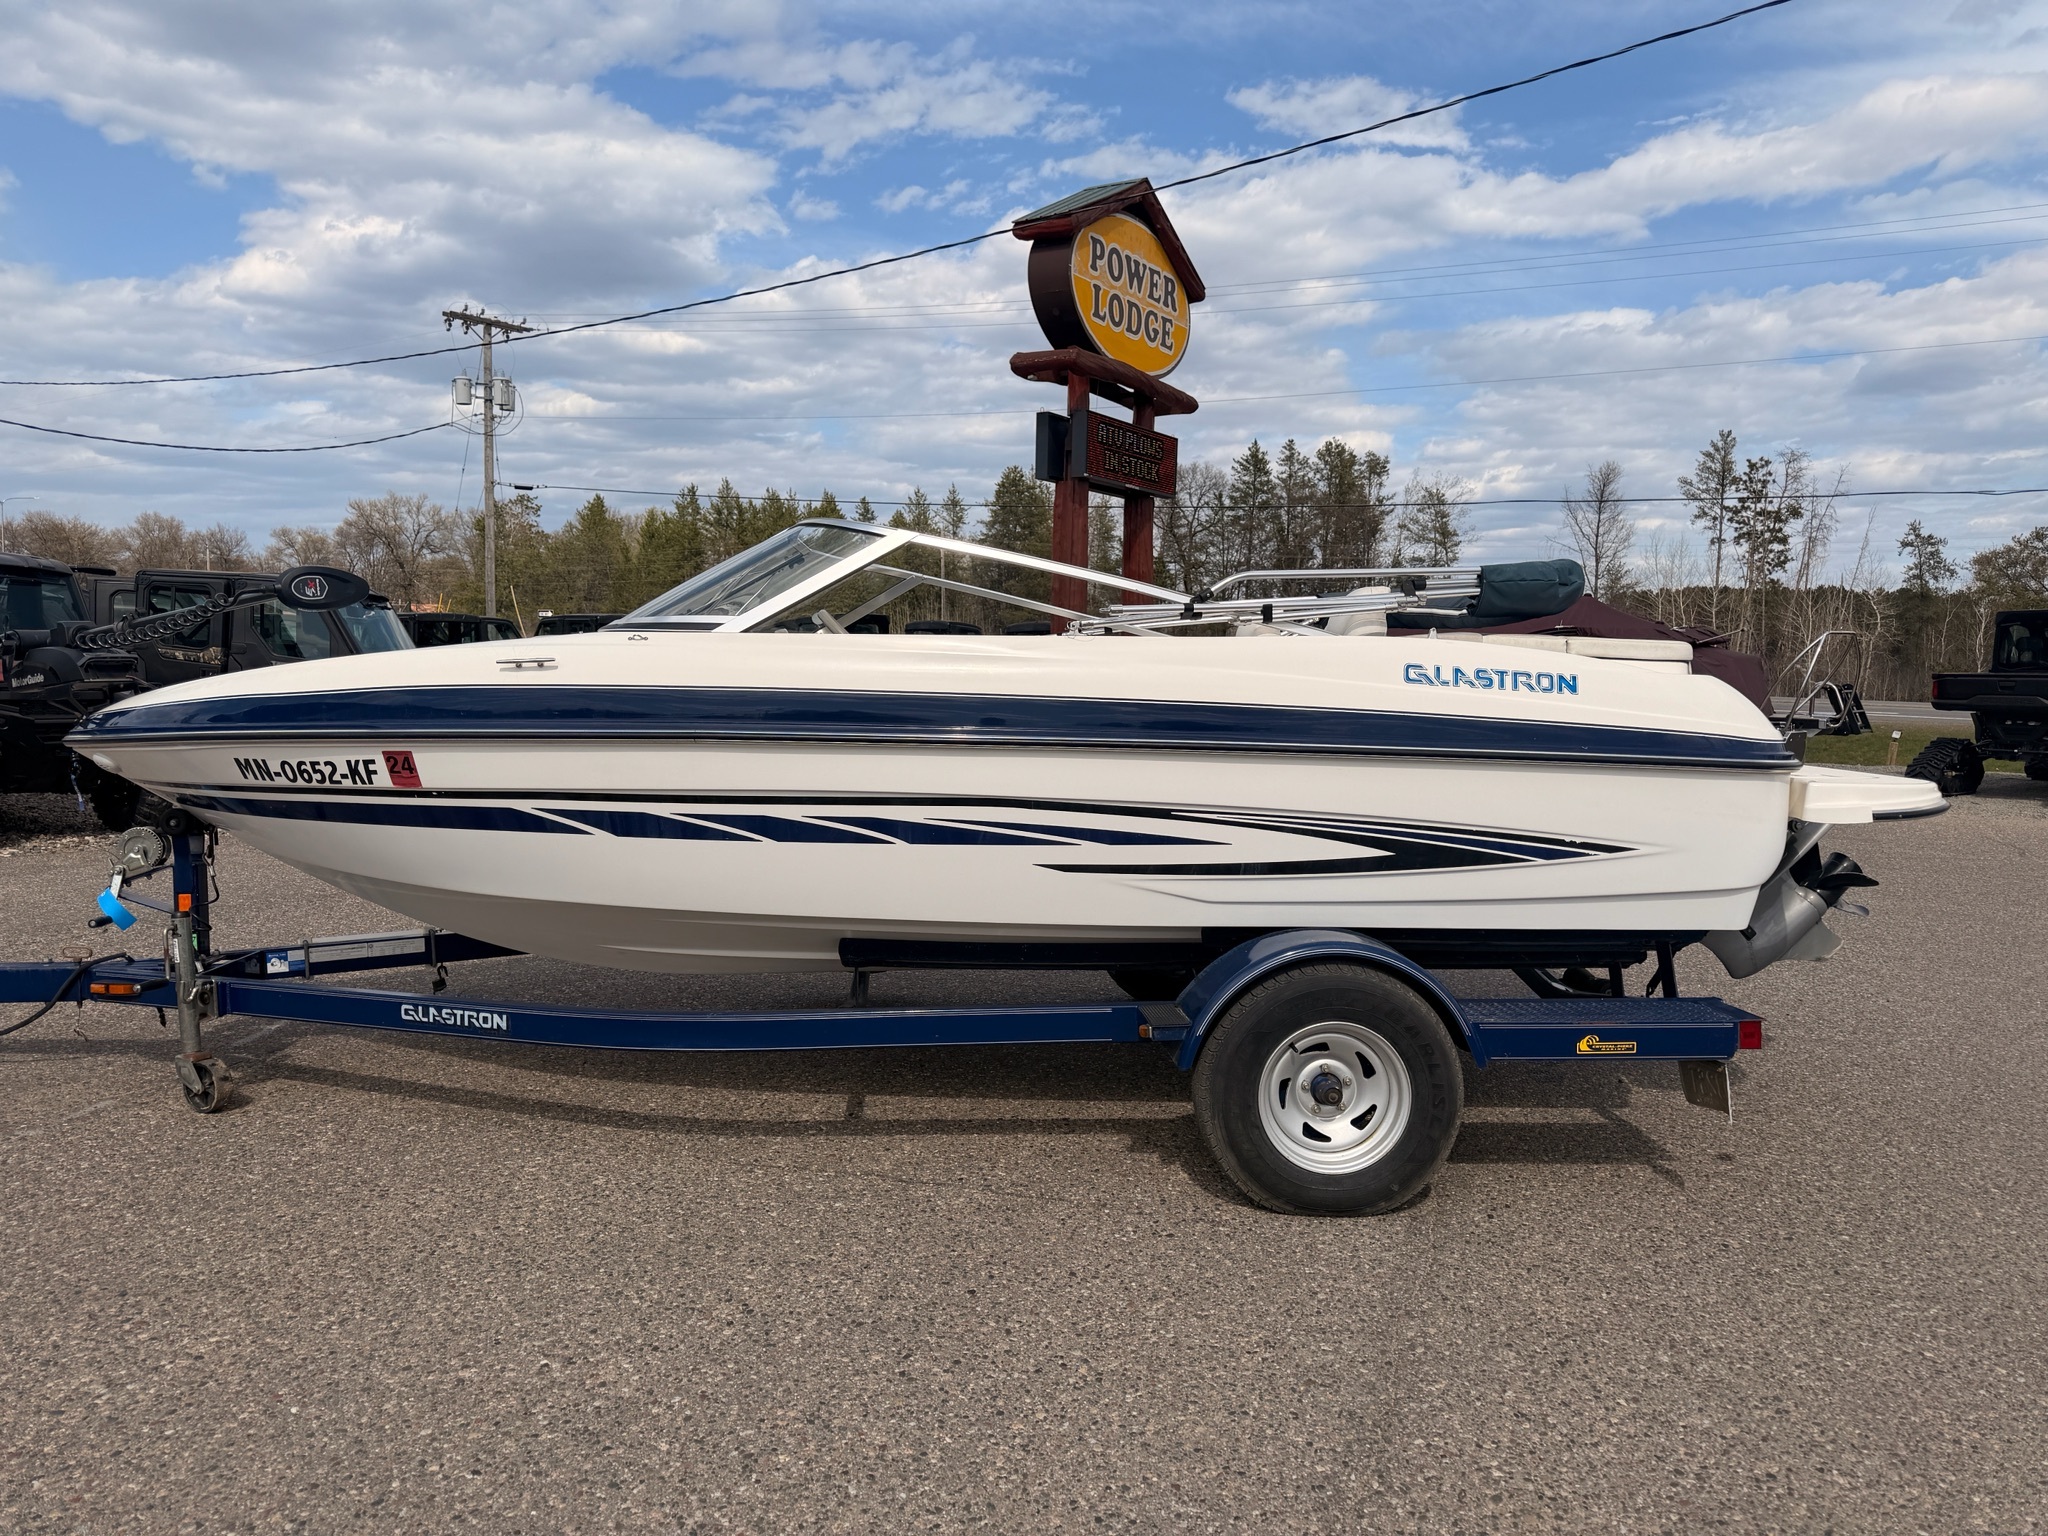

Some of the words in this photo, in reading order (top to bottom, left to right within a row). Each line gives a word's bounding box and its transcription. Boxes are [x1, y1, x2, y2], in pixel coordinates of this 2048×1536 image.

[1090, 234, 1178, 313] POWER
[1091, 283, 1174, 352] LODGE
[1104, 450, 1119, 471] IN
[1121, 455, 1159, 481] STOCK
[12, 672, 45, 688] MotorGuide
[1403, 662, 1579, 695] GLASTRON
[233, 757, 378, 785] MN-0652-KF
[386, 755, 415, 775] 24
[401, 1004, 507, 1031] GLASTRON
